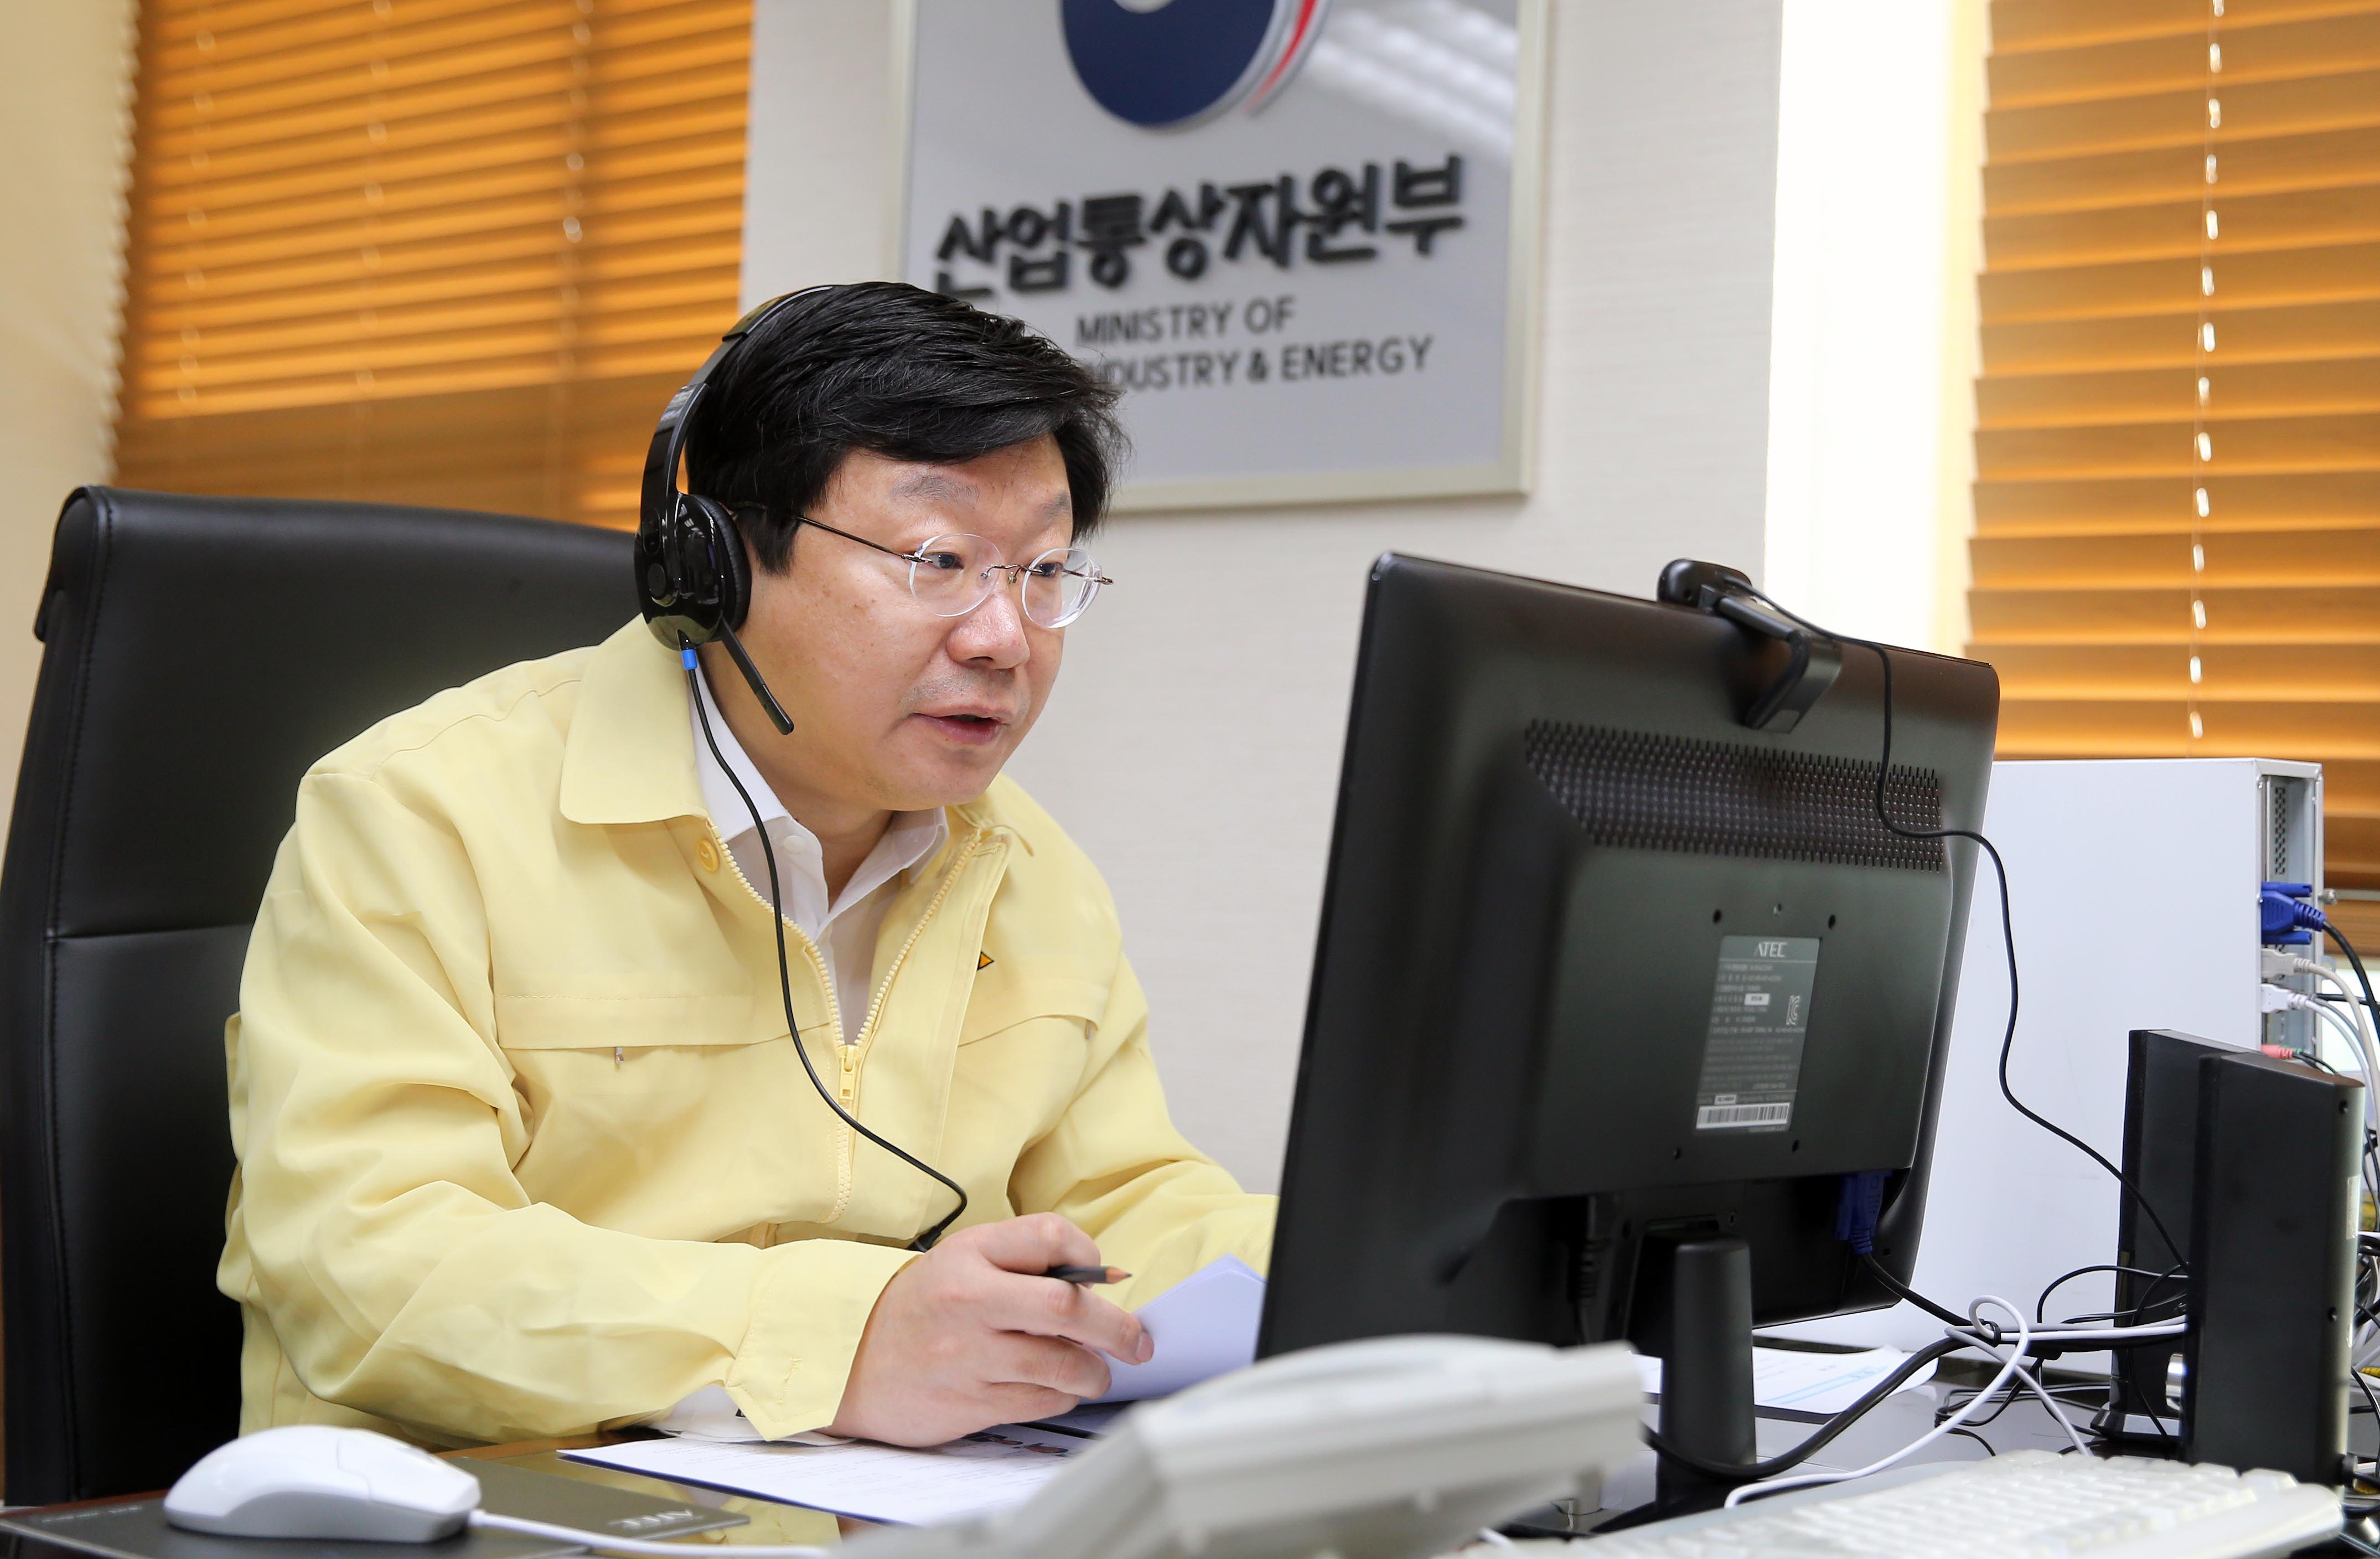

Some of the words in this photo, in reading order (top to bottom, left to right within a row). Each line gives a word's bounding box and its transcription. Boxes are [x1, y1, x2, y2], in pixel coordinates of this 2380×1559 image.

[935, 153, 1464, 299] 산업통상자원부
[1075, 302, 1234, 345] MINISTRY
[1244, 296, 1295, 334] OF
[1246, 347, 1269, 383] &
[1281, 334, 1434, 382] ENERGY
[1753, 942, 1788, 957] ATEC
